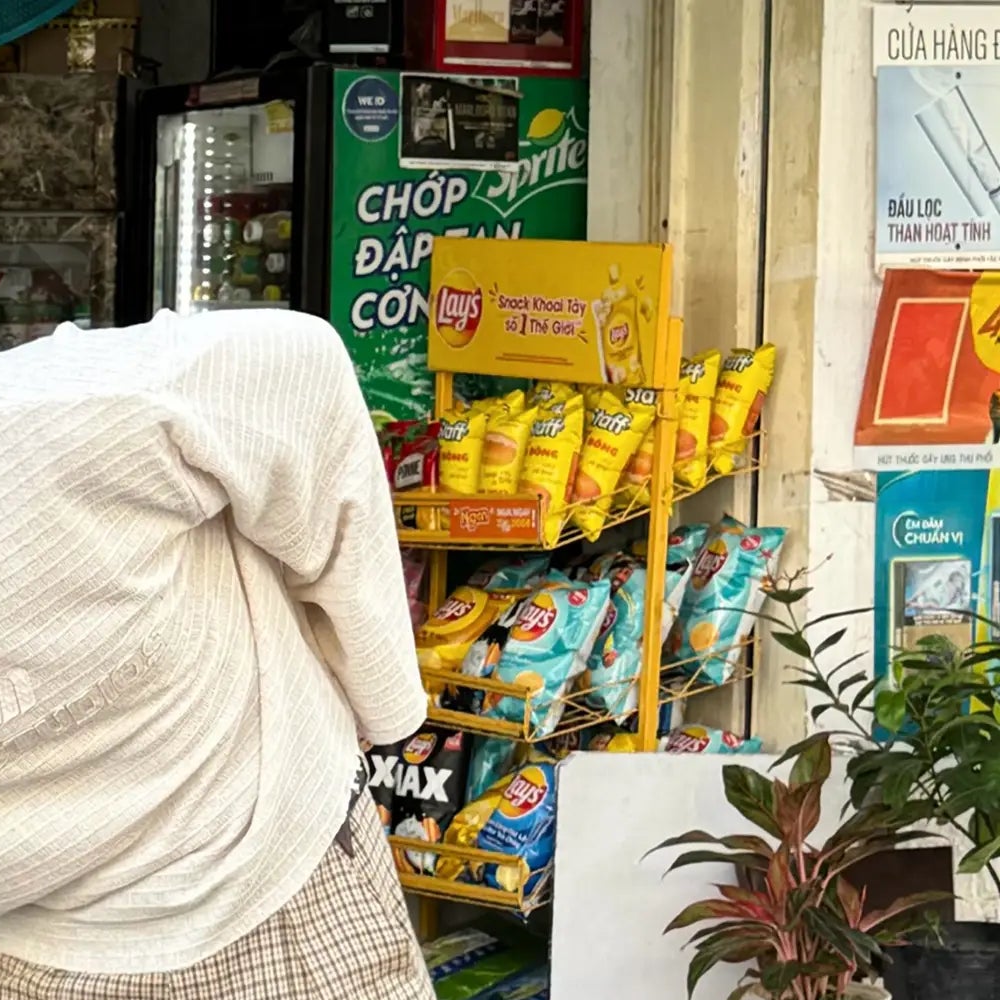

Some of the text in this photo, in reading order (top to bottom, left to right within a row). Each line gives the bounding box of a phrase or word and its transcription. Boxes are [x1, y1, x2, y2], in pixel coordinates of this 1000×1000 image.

[888, 23, 927, 60] CỬA
[933, 23, 987, 60] HÀNG
[358, 172, 467, 223] CHỚP
[888, 223, 923, 243] THAN
[356, 227, 432, 281] ĐẬP
[437, 287, 482, 330] Lay's
[499, 296, 529, 310] Snack
[533, 297, 563, 312] Khoai
